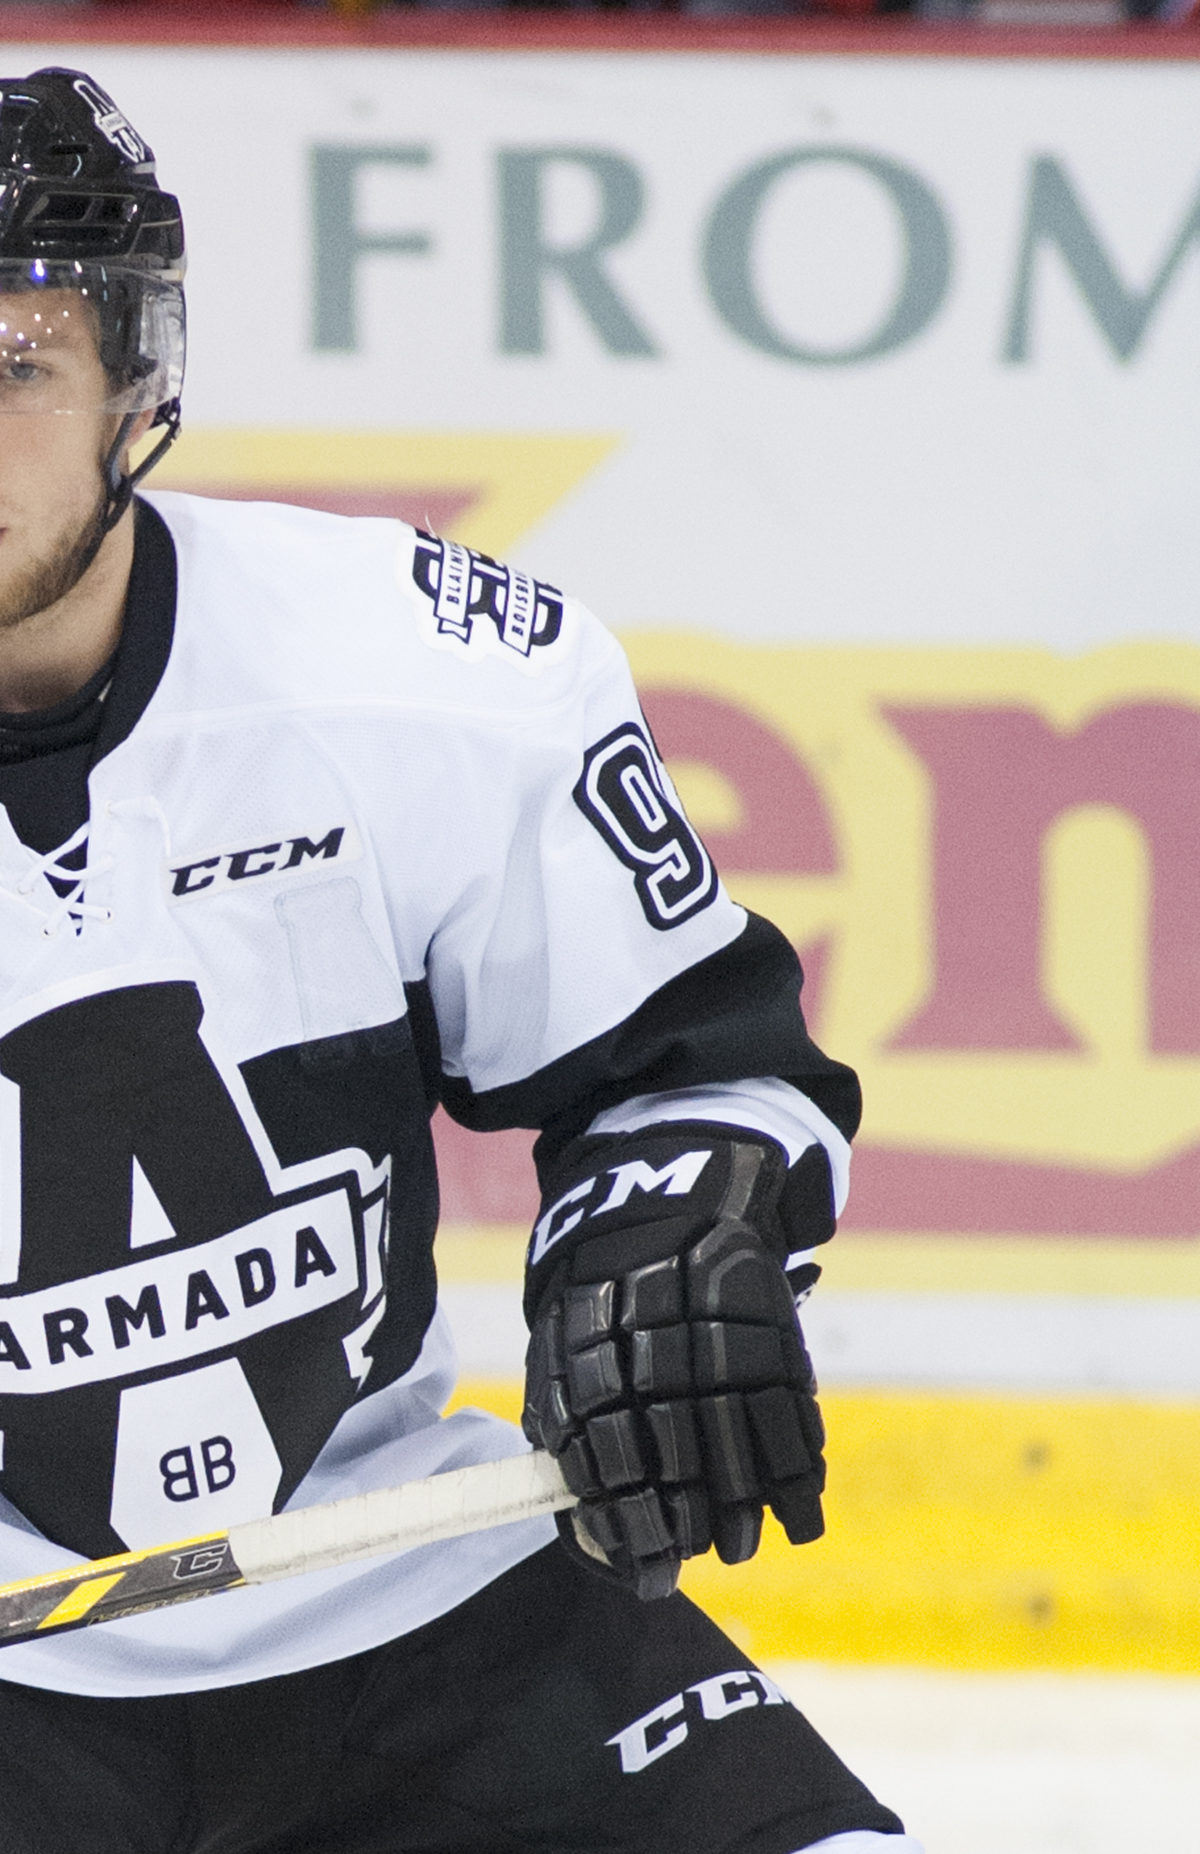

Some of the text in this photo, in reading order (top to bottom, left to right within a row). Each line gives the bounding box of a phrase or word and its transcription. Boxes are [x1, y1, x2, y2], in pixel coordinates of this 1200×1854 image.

[306, 143, 1200, 366] FROM
[170, 827, 345, 897] CCM
[531, 1149, 713, 1266] CM
